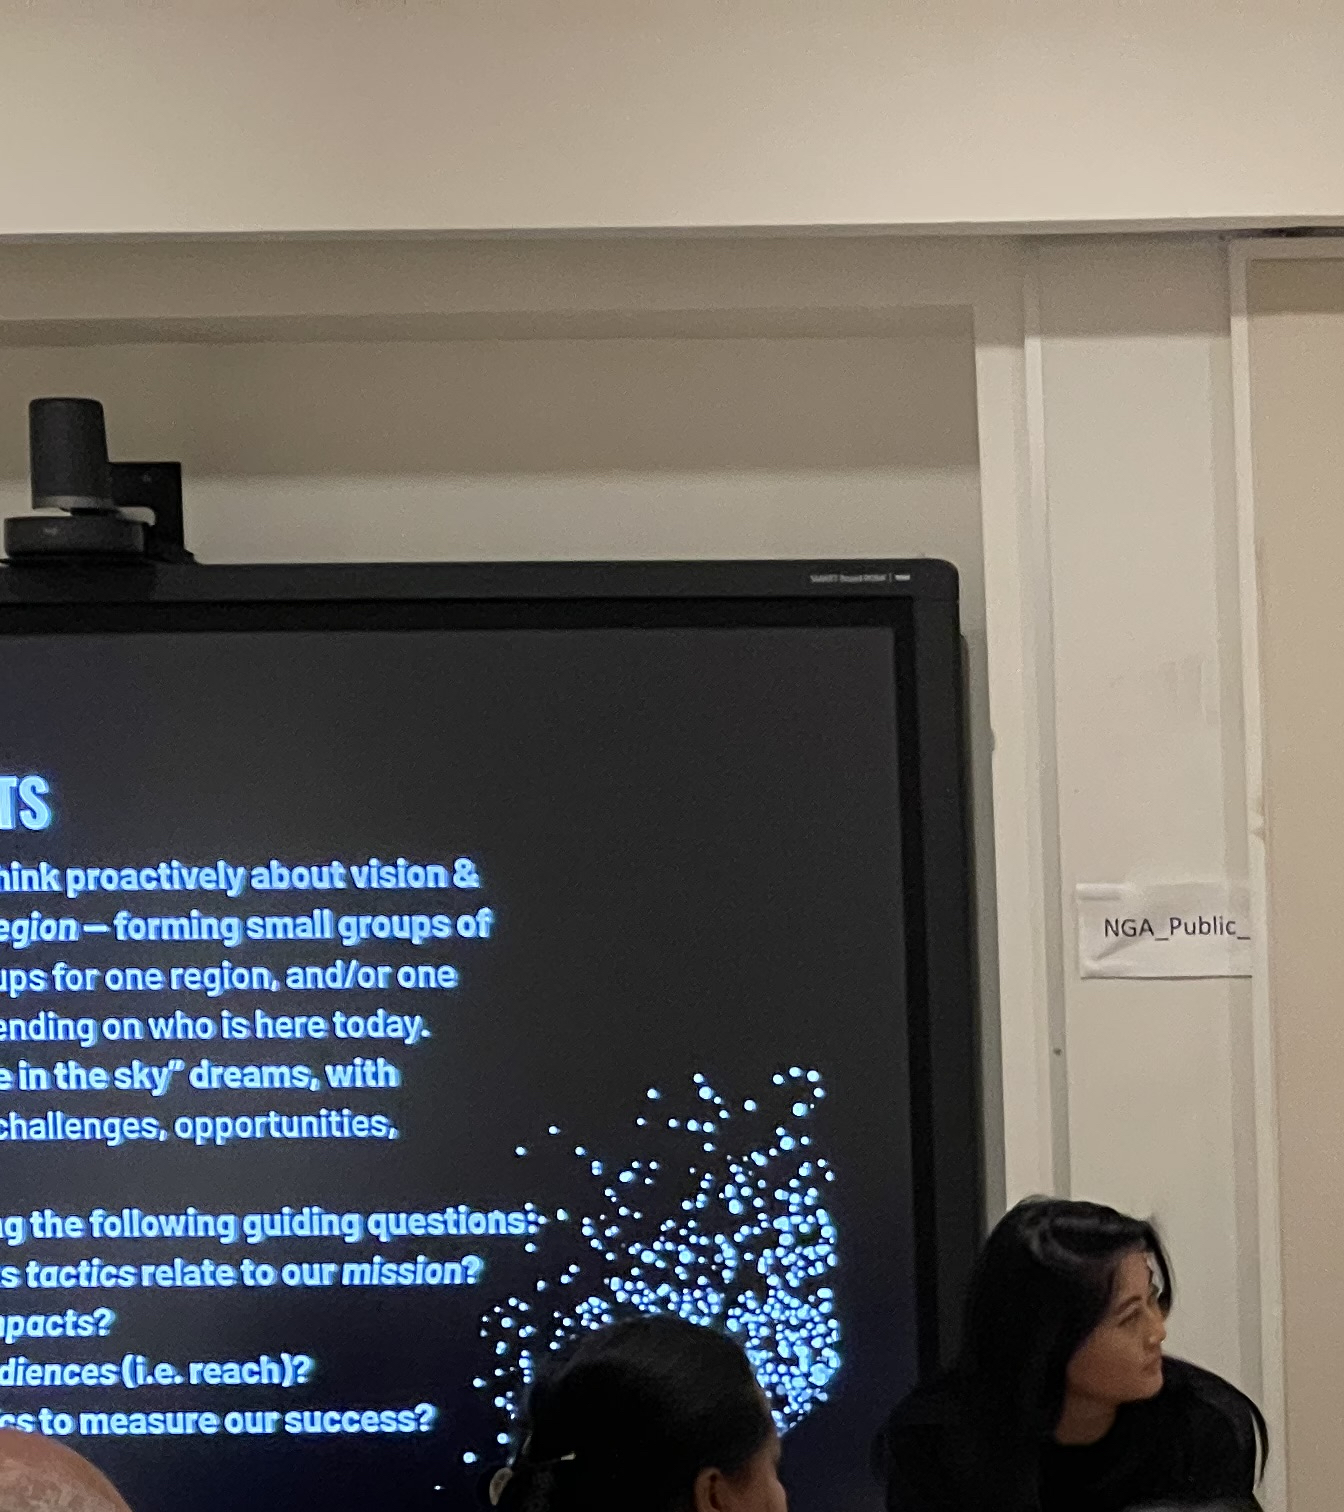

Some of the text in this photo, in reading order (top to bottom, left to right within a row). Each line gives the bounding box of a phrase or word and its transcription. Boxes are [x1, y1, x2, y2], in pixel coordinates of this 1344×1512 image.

[66, 858, 480, 898] proactively about vision &
[113, 907, 493, 947] forming small groups of
[1104, 906, 1251, 941] NGA_Public_
[52, 960, 458, 997] for one region, and/or one
[102, 1009, 430, 1044] on who is here today.
[19, 1058, 51, 1091] in
[52, 1060, 109, 1090] the
[189, 1059, 321, 1091] dreams,
[325, 1057, 400, 1088] with
[175, 1108, 399, 1145] opportunities,
[29, 1209, 85, 1238] the
[88, 1207, 237, 1244] following
[243, 1206, 363, 1244] guiding
[26, 1258, 138, 1288] tactics
[139, 1258, 236, 1287] relate
[240, 1259, 277, 1286] to
[280, 1263, 336, 1286] our
[342, 1255, 484, 1285] mission?
[120, 1352, 184, 1388] (i.e.
[189, 1353, 313, 1387] reach)?
[38, 1403, 436, 1435] to measure our success?
